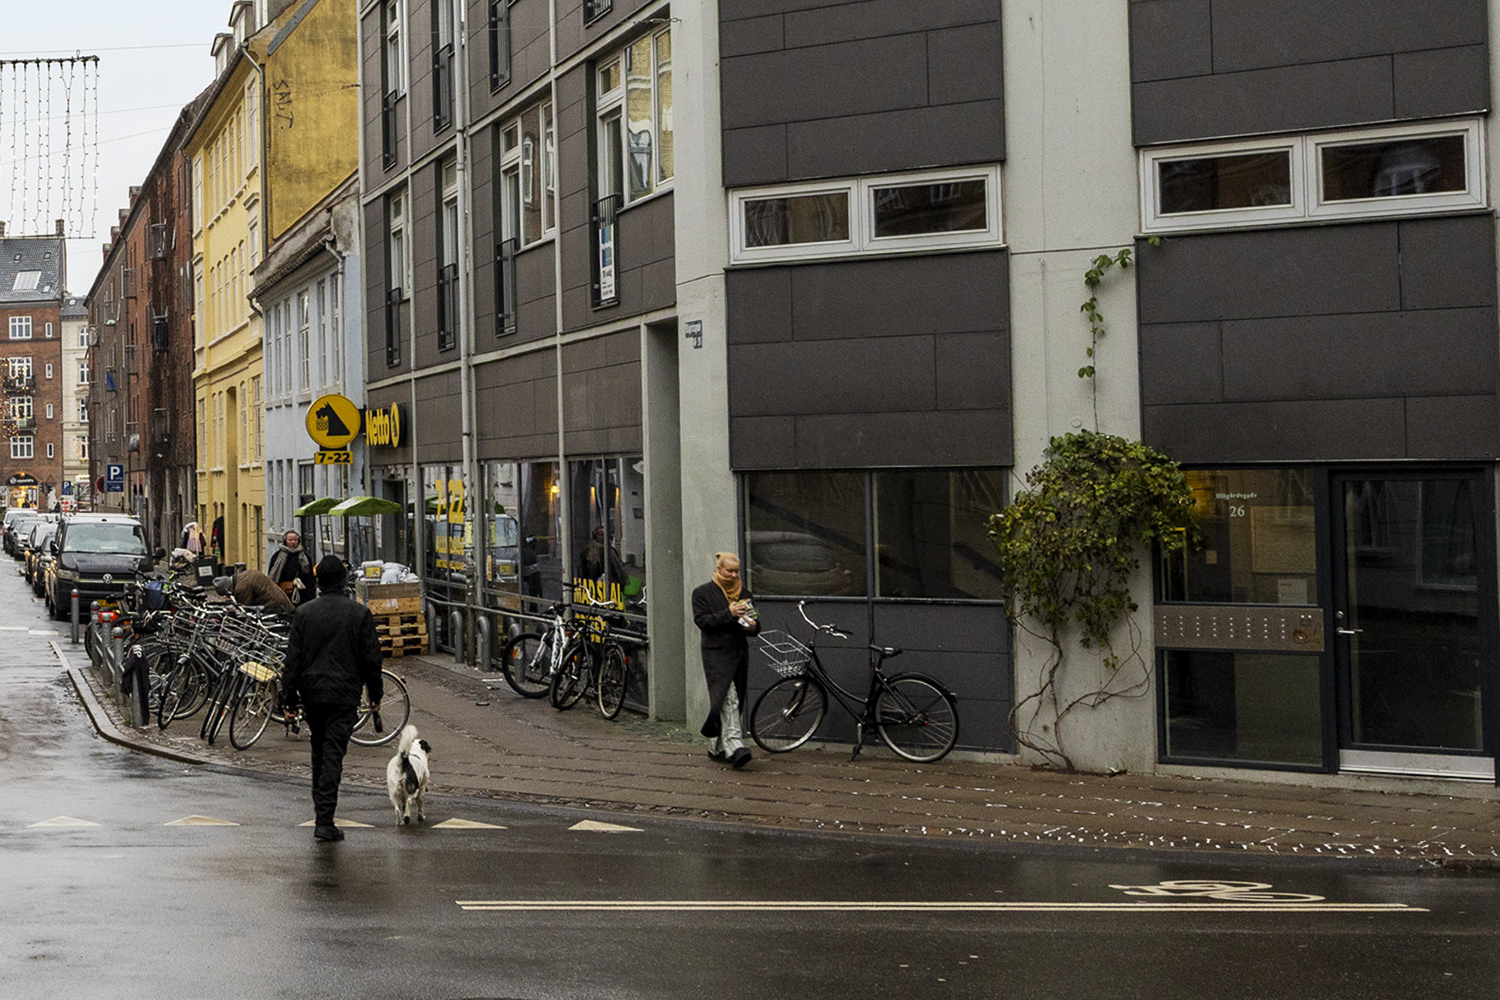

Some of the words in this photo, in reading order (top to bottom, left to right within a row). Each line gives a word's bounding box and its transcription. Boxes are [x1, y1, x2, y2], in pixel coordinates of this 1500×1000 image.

[365, 408, 390, 446] Netto
[318, 452, 350, 463] 7-22
[110, 466, 120, 481] P
[1229, 505, 1246, 518] 26
